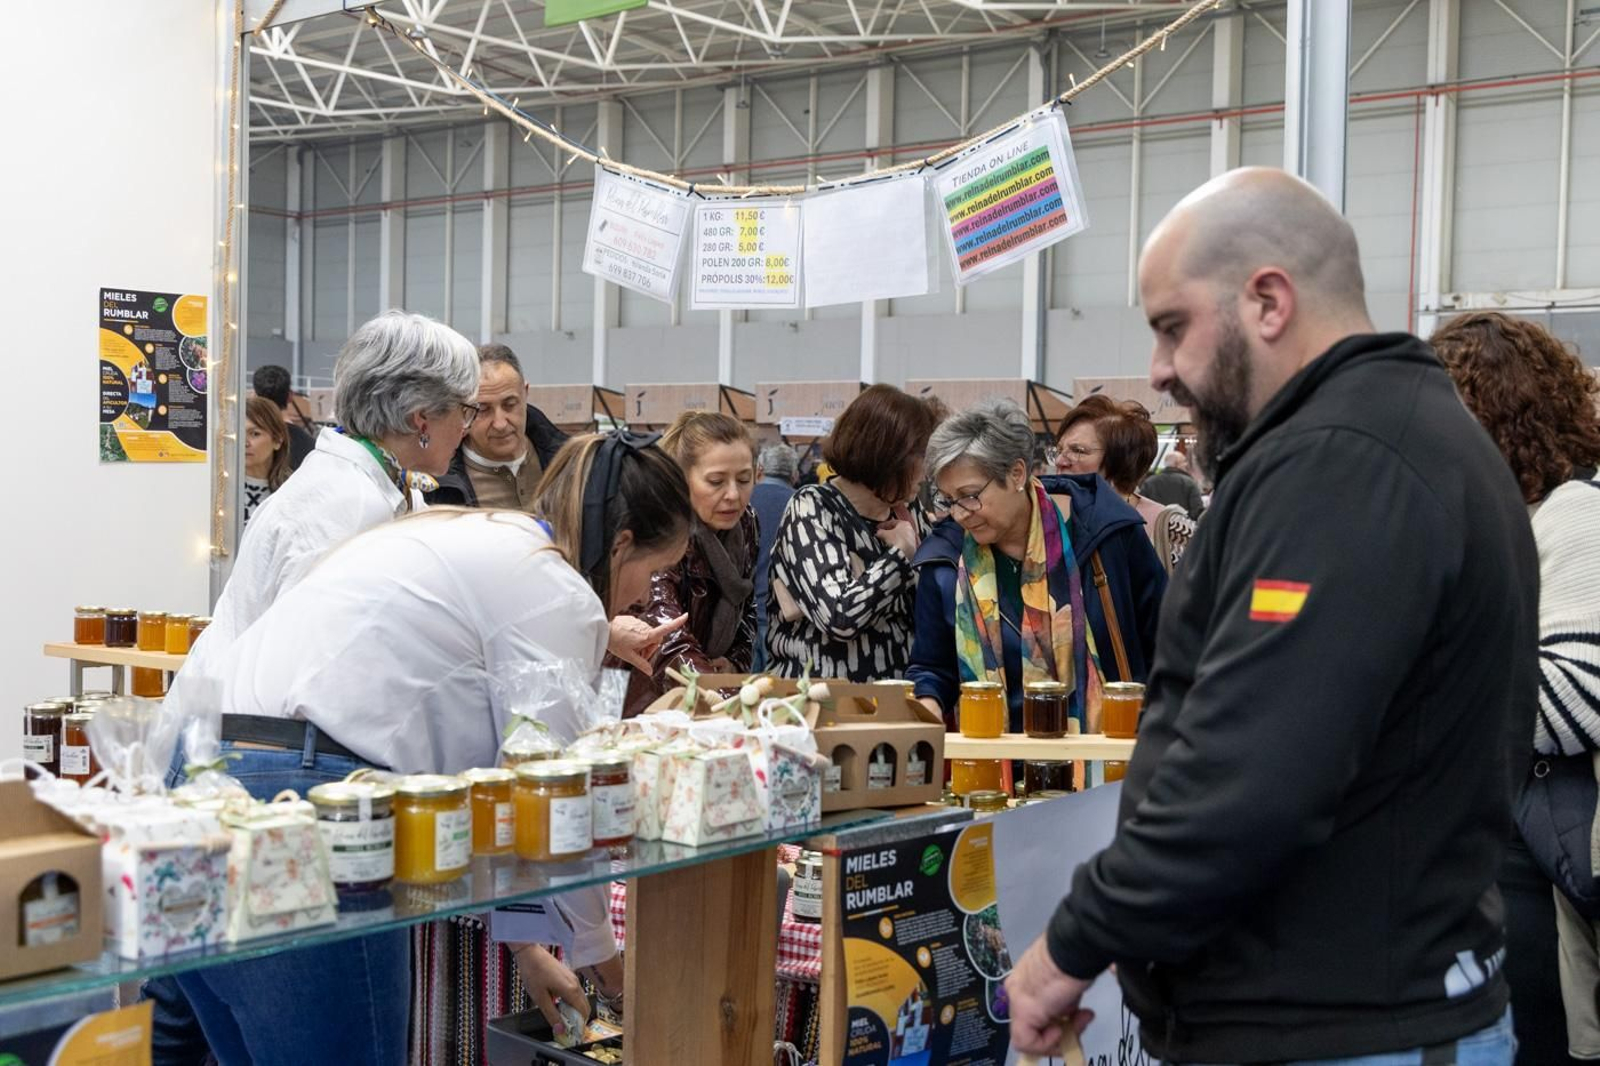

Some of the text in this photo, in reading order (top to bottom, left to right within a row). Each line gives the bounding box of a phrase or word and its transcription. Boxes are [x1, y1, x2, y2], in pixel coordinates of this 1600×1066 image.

[952, 141, 1029, 188] TIENDA ON LINE
[944, 150, 1050, 209] www.reinadelrumblar.com
[949, 166, 1054, 223] www.reinadelrumblar.com
[709, 211, 724, 221] KG:
[735, 210, 758, 222] 11,50
[760, 210, 766, 220] €
[952, 182, 1059, 239] www.reinadelrumblar.com
[703, 226, 766, 237] 480 GR: 7,00 €
[956, 198, 1063, 254] www.reinadelrumblar.com
[703, 242, 764, 253] 280 GR: 5,00 €
[960, 213, 1067, 269] www.reinadelrumblar.com
[702, 258, 790, 268] POLEN 200 GR: 8,00€
[608, 263, 651, 288] 699 837 706
[701, 272, 743, 284] PRÓPOLIS
[103, 292, 137, 302] MIELES
[103, 308, 149, 319] RUMBLAR
[846, 849, 897, 874] MIELES
[846, 874, 868, 891] DEL
[846, 880, 914, 910] RUMBLAR
[851, 1017, 869, 1028] MIEL
